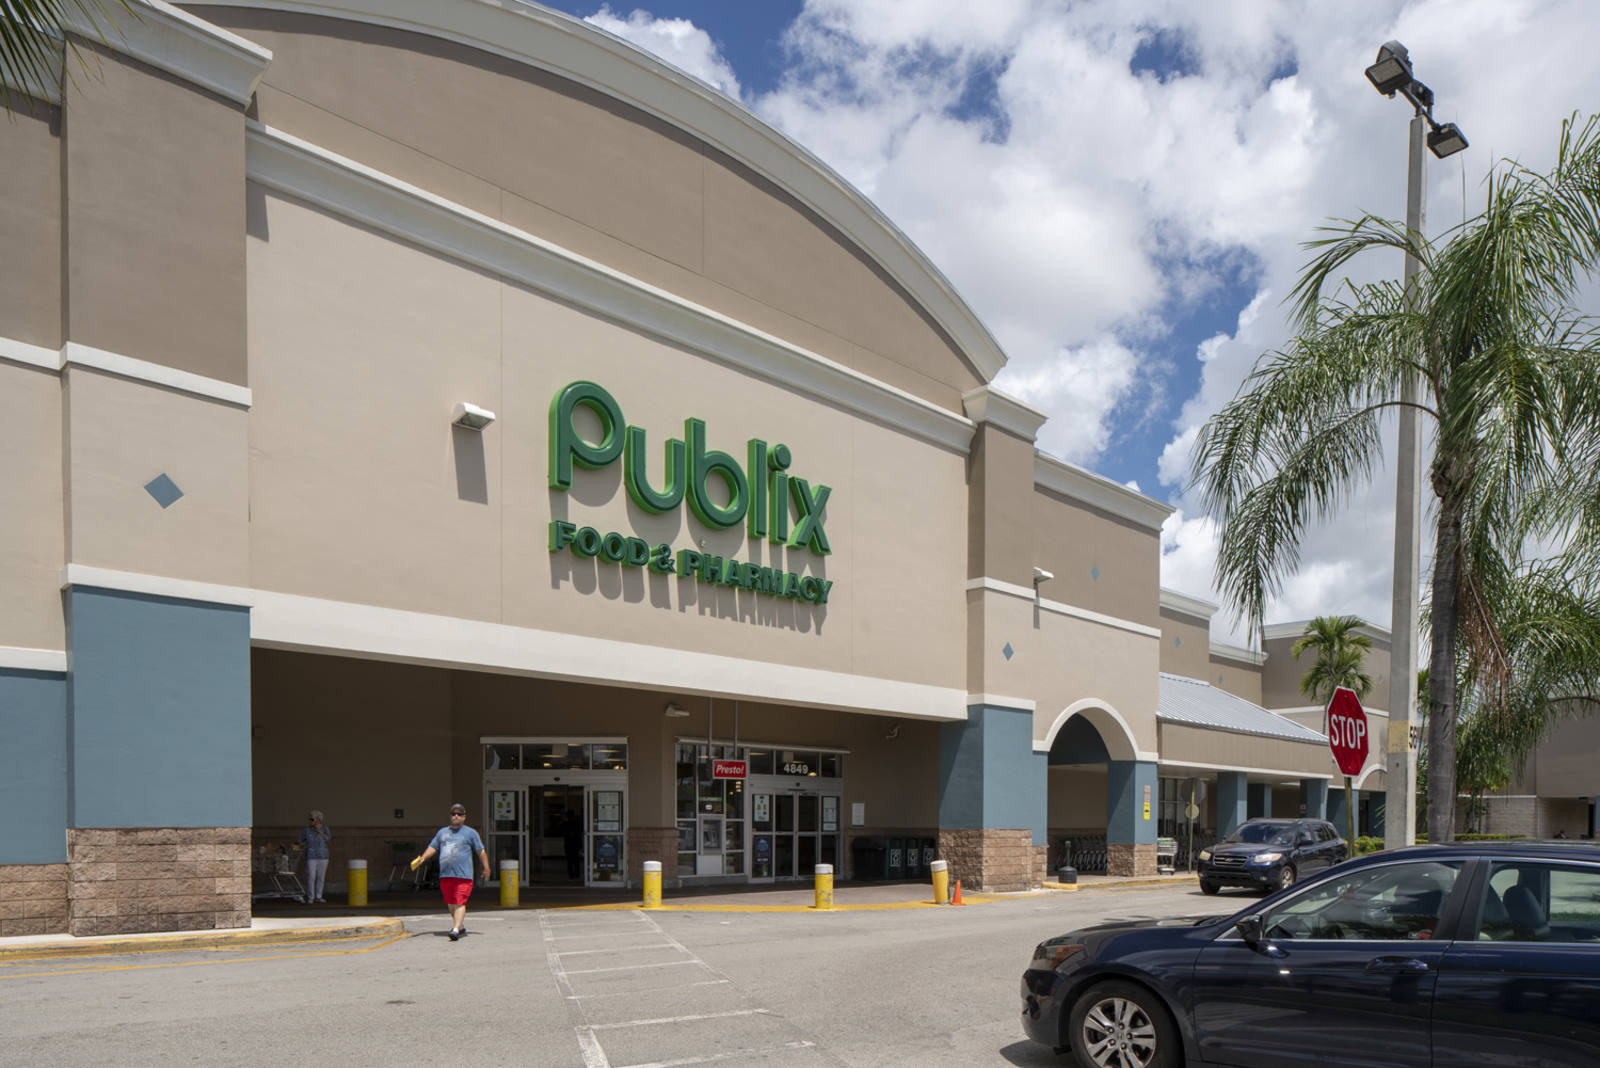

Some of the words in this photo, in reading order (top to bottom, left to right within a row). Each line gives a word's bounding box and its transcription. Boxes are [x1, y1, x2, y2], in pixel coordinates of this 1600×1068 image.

[548, 380, 832, 555] Publix
[548, 520, 650, 567] FOOD
[648, 543, 677, 574] &
[677, 549, 834, 605] PHARMACY
[1330, 713, 1366, 750] STOP
[716, 764, 745, 775] Presto!
[783, 763, 809, 775] 4849
